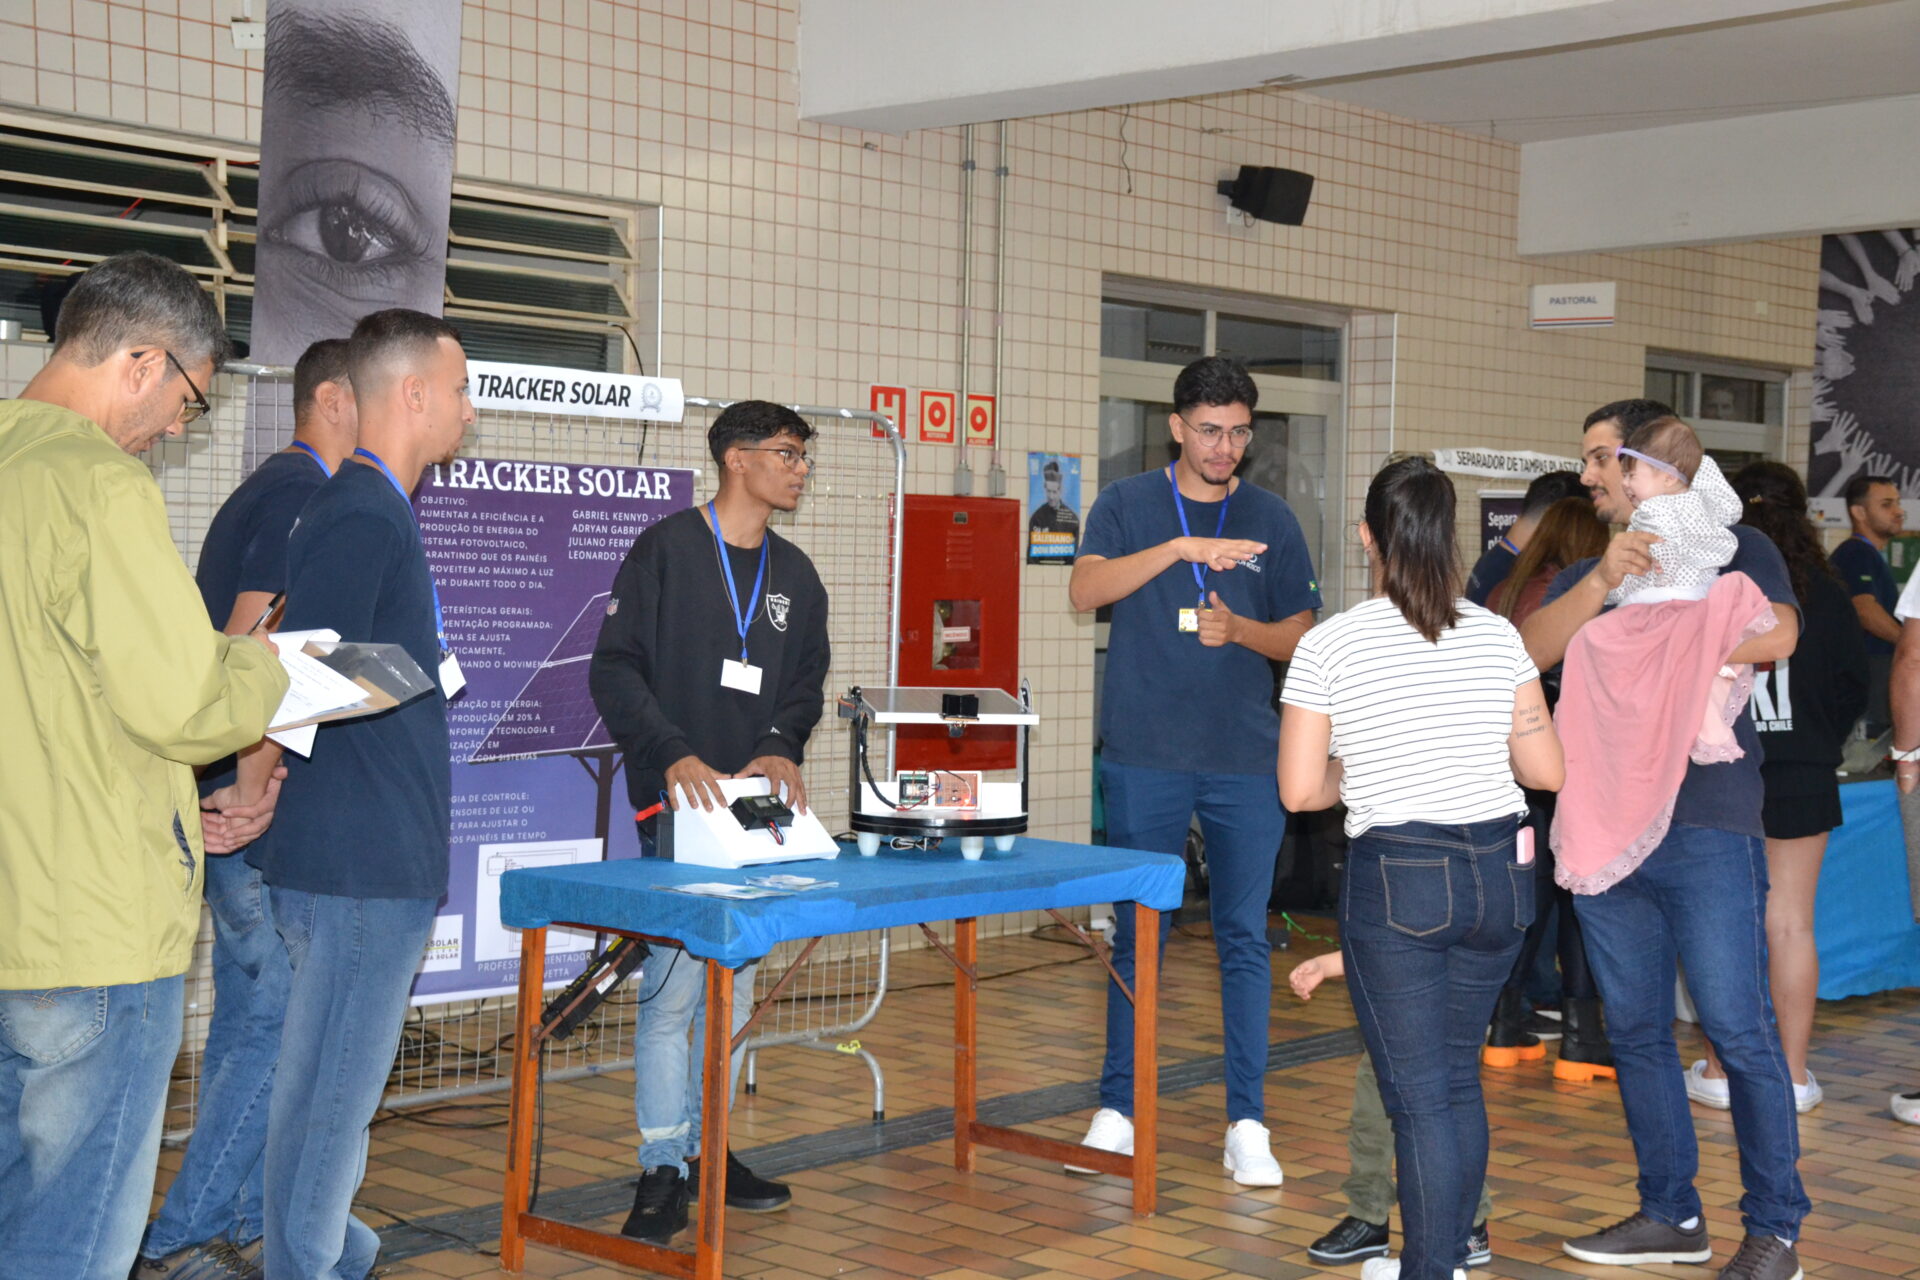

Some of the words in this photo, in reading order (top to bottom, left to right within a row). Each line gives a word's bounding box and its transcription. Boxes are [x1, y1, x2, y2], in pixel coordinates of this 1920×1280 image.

[1549, 296, 1597, 305] PASTORAL
[478, 374, 566, 402] TRACKER
[569, 381, 631, 407] SOLAR
[1456, 451, 1506, 470] SEPARADOR
[1507, 456, 1518, 472] DE
[428, 459, 572, 494] TRACKER
[578, 467, 671, 500] SOLAR
[420, 496, 468, 506] OBJETIVO:
[420, 510, 469, 519] AUMENTAR
[472, 512, 477, 520] A
[480, 512, 529, 523] EFICIÊNCIA
[531, 515, 536, 523] E
[539, 515, 545, 524] A
[572, 510, 609, 521] GABRIEL
[612, 512, 649, 522] KENNYD
[1488, 512, 1518, 530] Separa
[420, 523, 470, 534] PRODUÇÃO
[473, 526, 483, 534] DE
[486, 526, 523, 535] ENERGIA
[526, 528, 539, 536] DO
[572, 523, 608, 534] ADRYAN
[460, 539, 528, 550] FOTOVOLTAICO,
[568, 537, 606, 547] JULIANO
[608, 539, 636, 548] FERRE
[425, 551, 478, 560] ARANTINDO
[481, 553, 498, 562] QUE
[501, 553, 512, 562] OS
[515, 553, 548, 563] PAINÉIS
[568, 550, 616, 561] LEONARDO
[430, 565, 476, 574] ROVEITEM
[478, 567, 490, 575] AO
[493, 565, 529, 576] MÁXIMO
[531, 568, 537, 576] A
[539, 569, 554, 577] LUZ
[450, 579, 490, 588] DURANTE
[493, 580, 517, 589] TODO
[519, 581, 526, 589] O
[528, 581, 546, 590] DIA.
[442, 605, 497, 615] CTERÍSTICAS
[500, 607, 533, 616] GERAIS:
[442, 619, 489, 630] MENTAÇÃO
[492, 621, 553, 630] PROGRAMADA:
[466, 633, 477, 641] SE
[479, 633, 511, 642] AJUSTA
[495, 660, 501, 669] O
[491, 700, 501, 708] DE
[505, 699, 542, 709] ENERGIA:
[452, 713, 502, 723] PRODUÇÃO
[503, 714, 514, 722] EM
[517, 713, 532, 722] 20%
[535, 713, 541, 721] A
[449, 728, 486, 736] NFORME
[496, 726, 548, 735] TECNOLOGIA
[551, 726, 556, 734] E
[1769, 720, 1793, 732] CHILE
[449, 740, 485, 751] IZAÇÃO,
[488, 741, 500, 749] EM
[469, 794, 479, 803] DE
[481, 792, 529, 802] CONTROLE:
[450, 808, 487, 817] ENSORES
[489, 806, 500, 815] DE
[503, 805, 519, 814] LUZ
[521, 805, 535, 813] OU
[458, 821, 479, 830] PARA
[481, 819, 518, 829] AJUSTAR
[521, 818, 528, 827] O
[466, 832, 498, 843] PAINÉIS
[502, 832, 514, 841] EM
[517, 831, 547, 840] TEMPO
[478, 961, 520, 972] PROFESS
